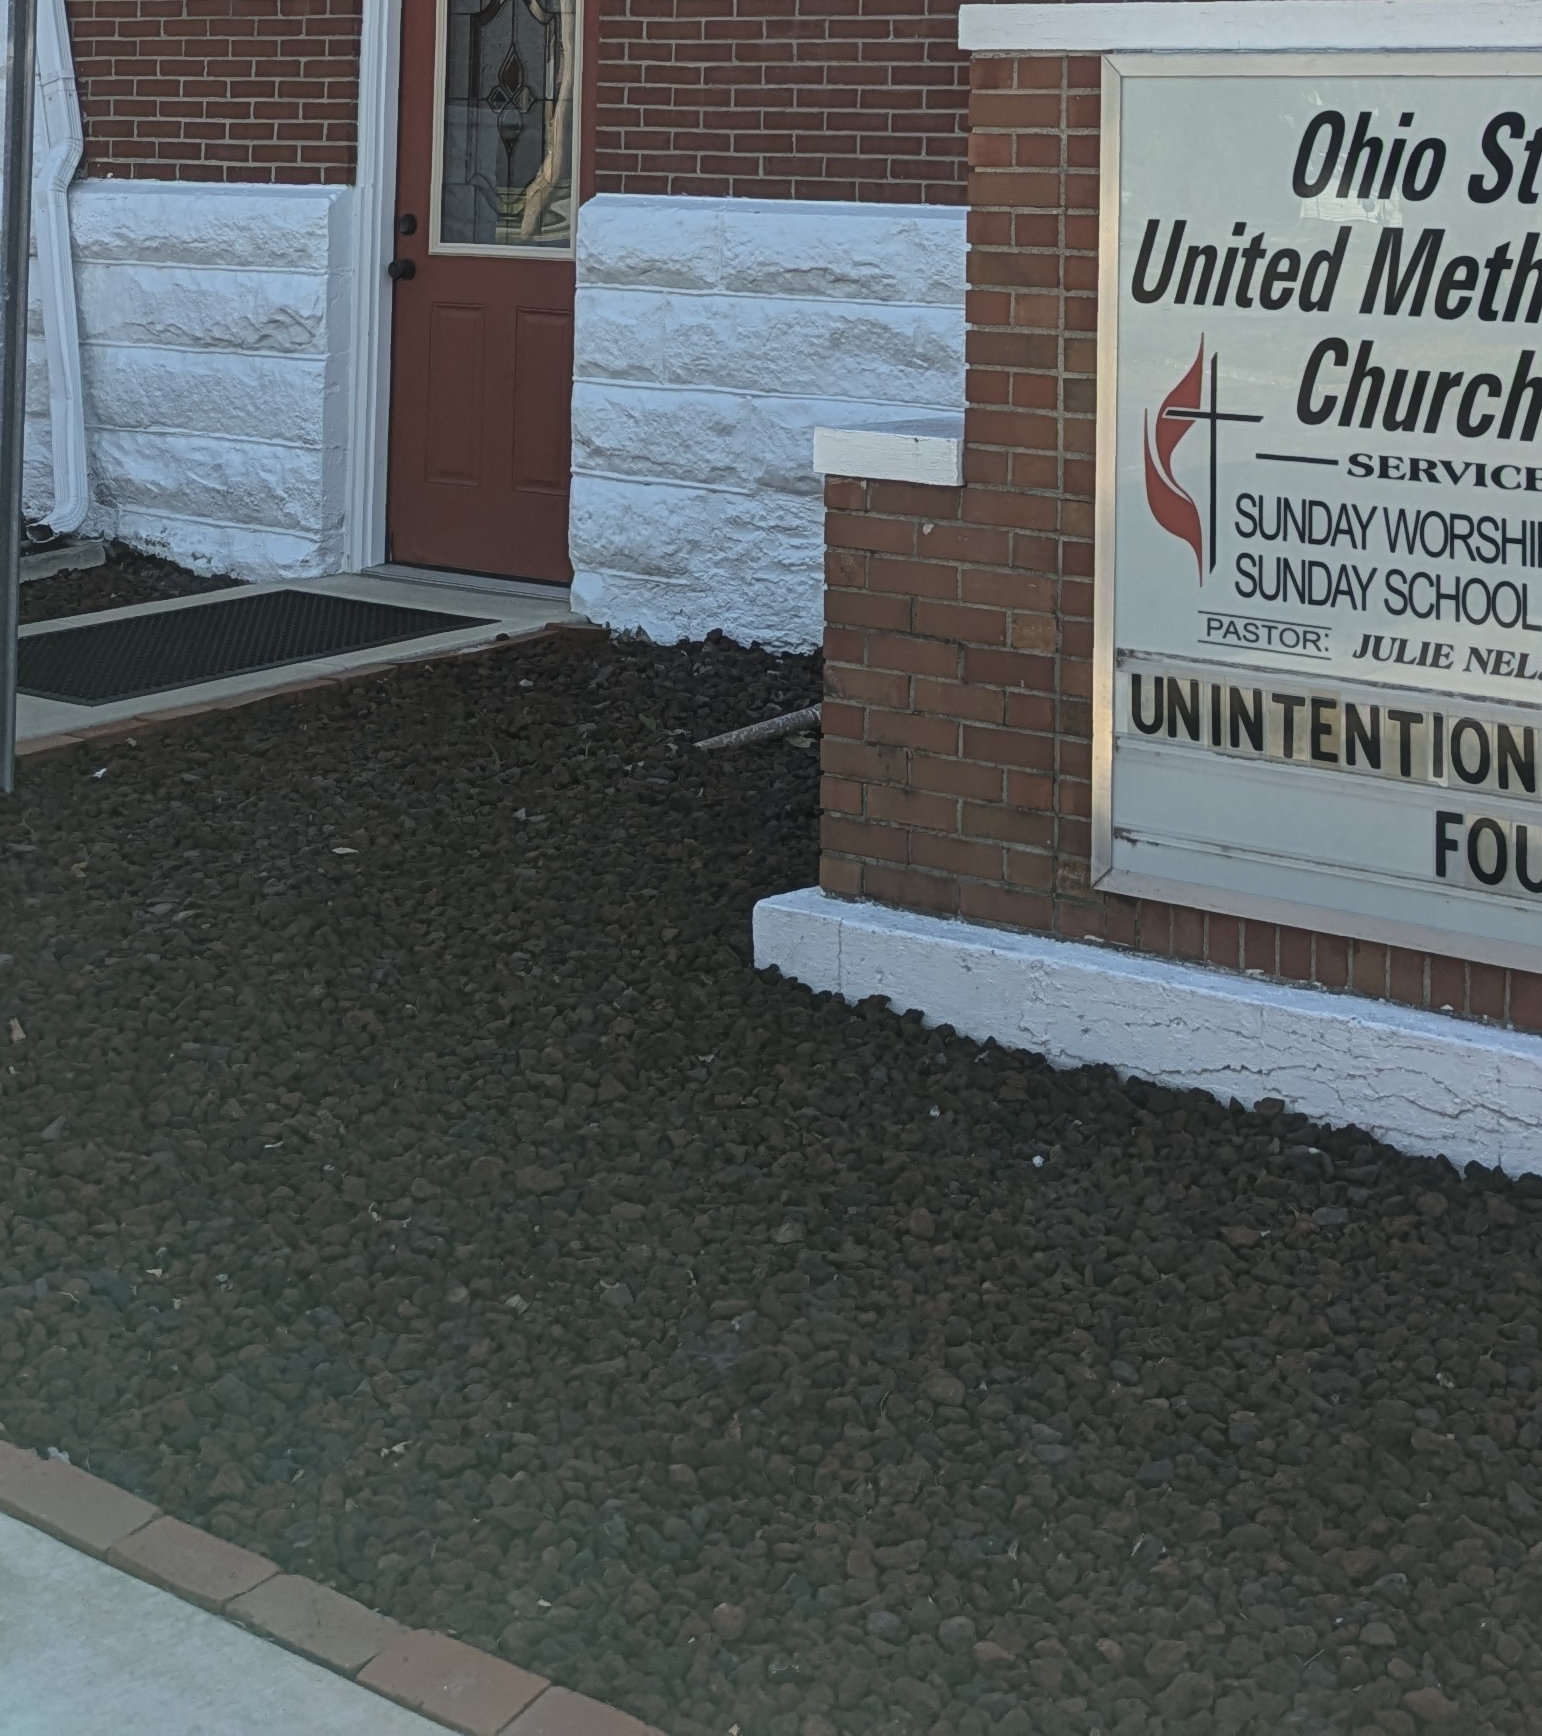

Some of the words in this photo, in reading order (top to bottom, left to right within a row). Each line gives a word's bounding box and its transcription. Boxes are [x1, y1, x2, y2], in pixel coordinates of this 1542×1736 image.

[1291, 109, 1446, 202] Ohio
[1130, 218, 1352, 314] United
[1233, 493, 1378, 551] SUNDAY
[1233, 551, 1378, 610] SUNDAY
[1382, 568, 1542, 633] SCHOOL
[1204, 616, 1331, 654] PASTOR:
[1352, 633, 1456, 671] JULIE
